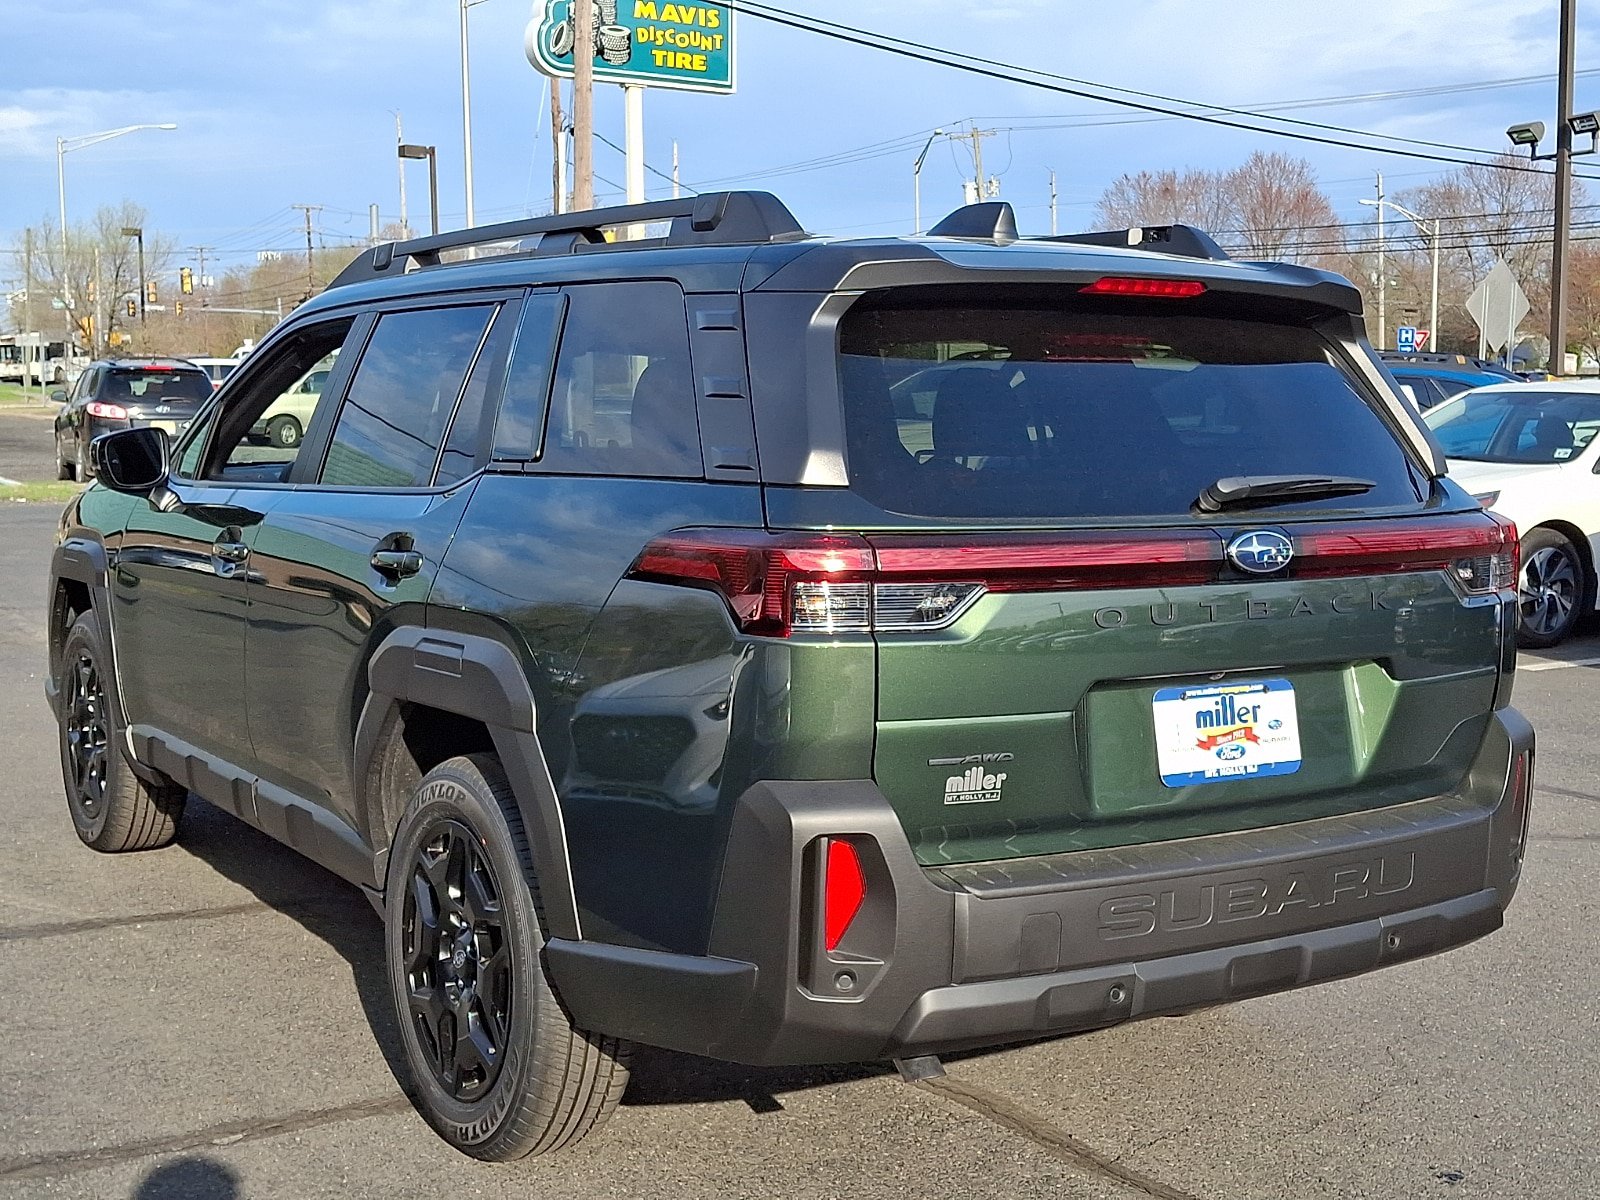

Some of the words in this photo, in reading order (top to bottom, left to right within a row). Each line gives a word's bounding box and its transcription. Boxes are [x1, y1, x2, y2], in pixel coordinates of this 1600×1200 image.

[633, 0, 720, 28] MAVIS
[636, 26, 723, 51] DISCOUNT
[652, 50, 707, 71] TIRE
[1401, 330, 1413, 343] H
[1094, 592, 1391, 628] OUTBACK
[1196, 696, 1261, 728] miller
[945, 766, 1007, 792] miller
[1098, 852, 1416, 941] SUBARU
